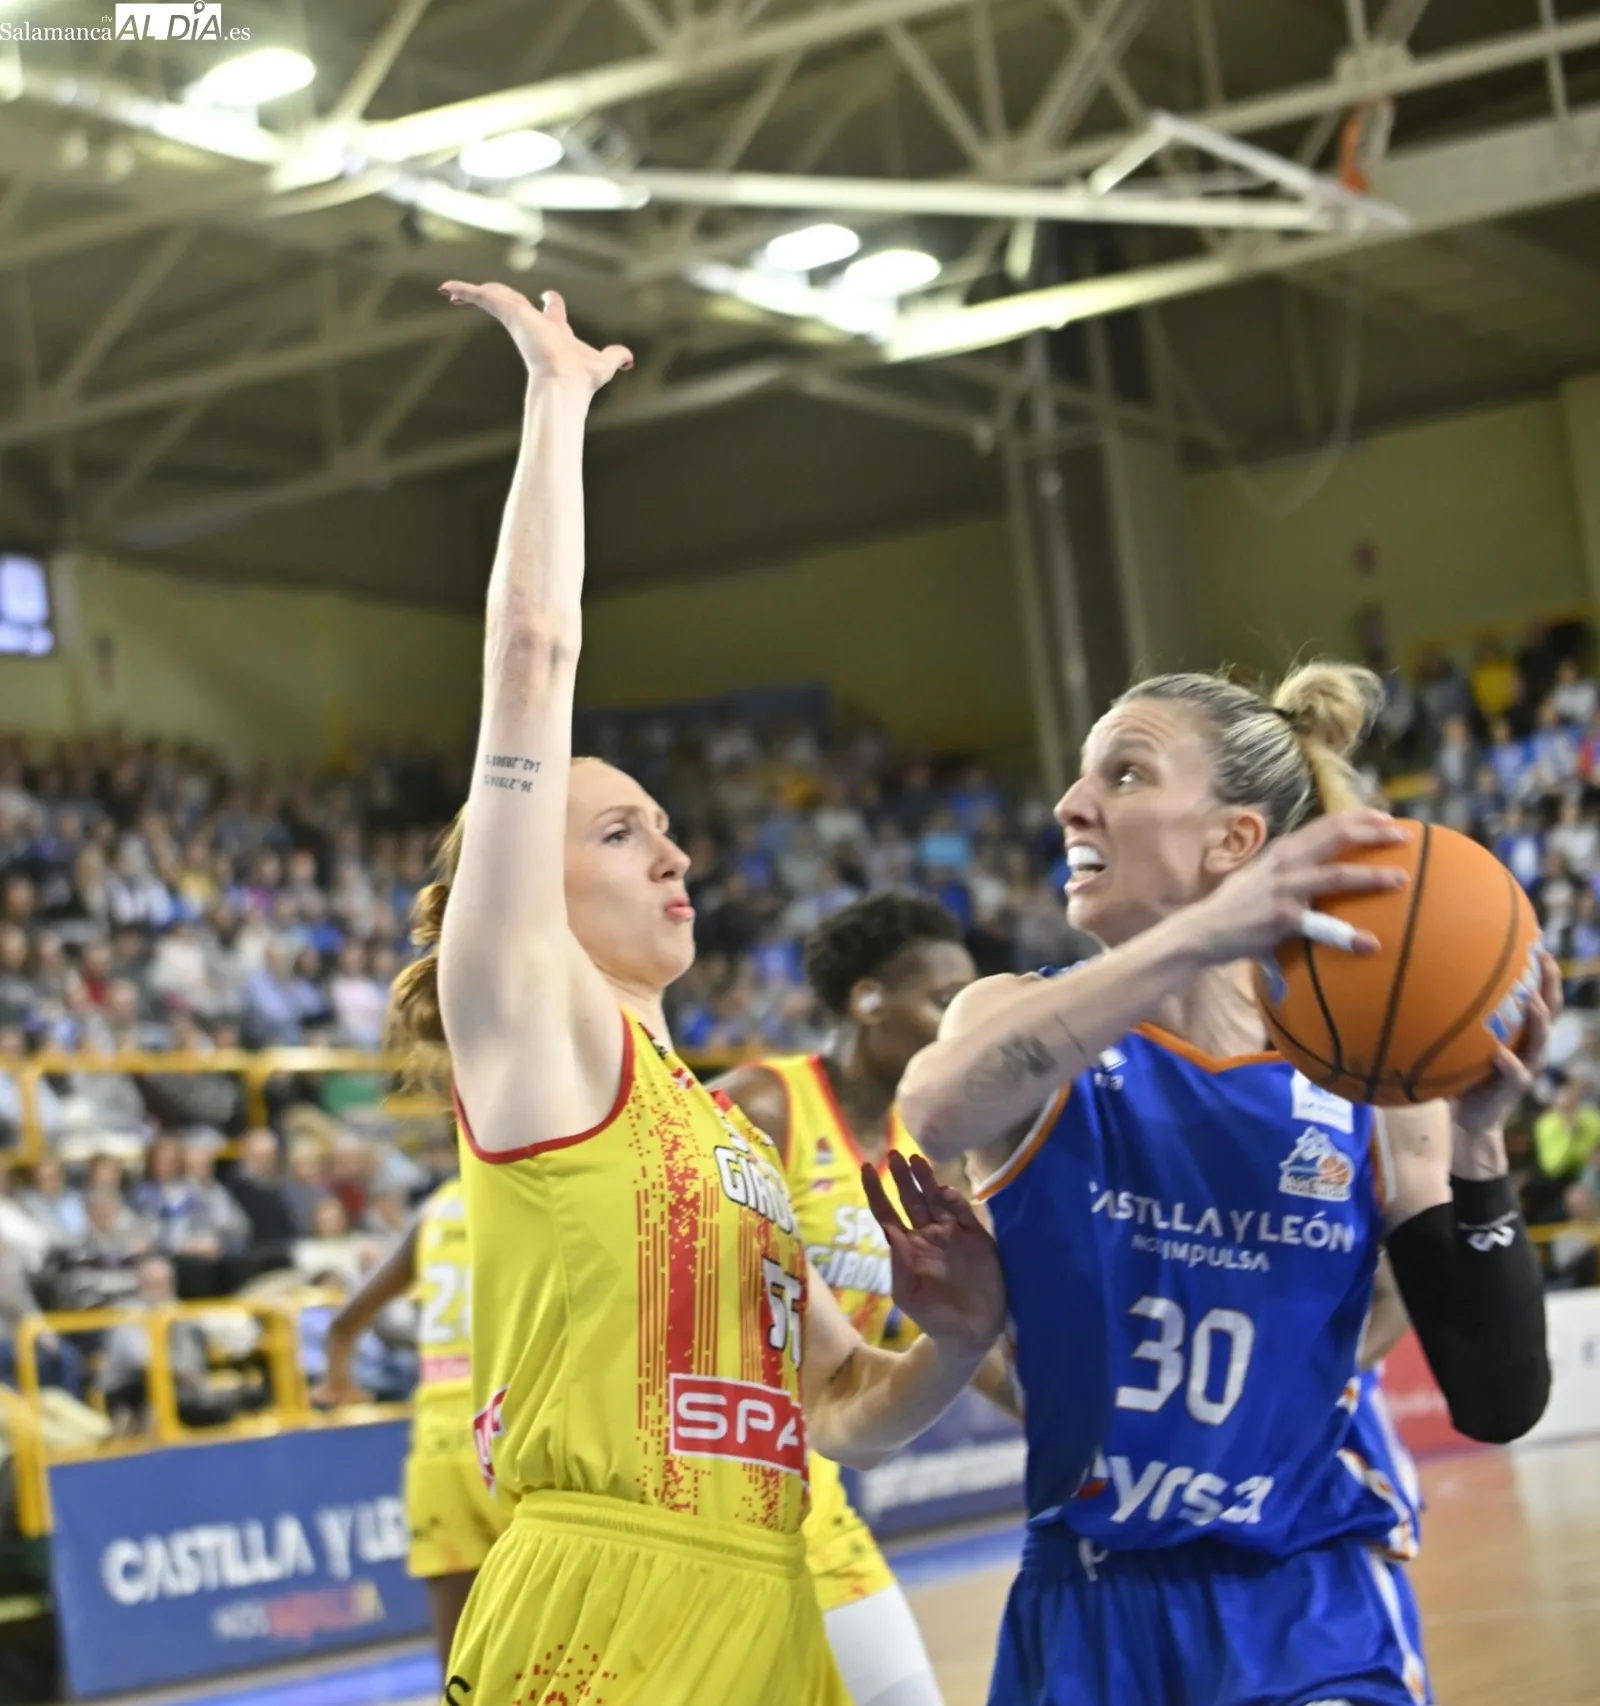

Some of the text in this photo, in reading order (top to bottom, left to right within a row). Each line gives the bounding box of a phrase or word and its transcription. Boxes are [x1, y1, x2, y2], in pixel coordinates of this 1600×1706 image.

[1229, 1210, 1254, 1243] Y
[1258, 1210, 1356, 1253] LEÓN
[1115, 1295, 1255, 1426] 30
